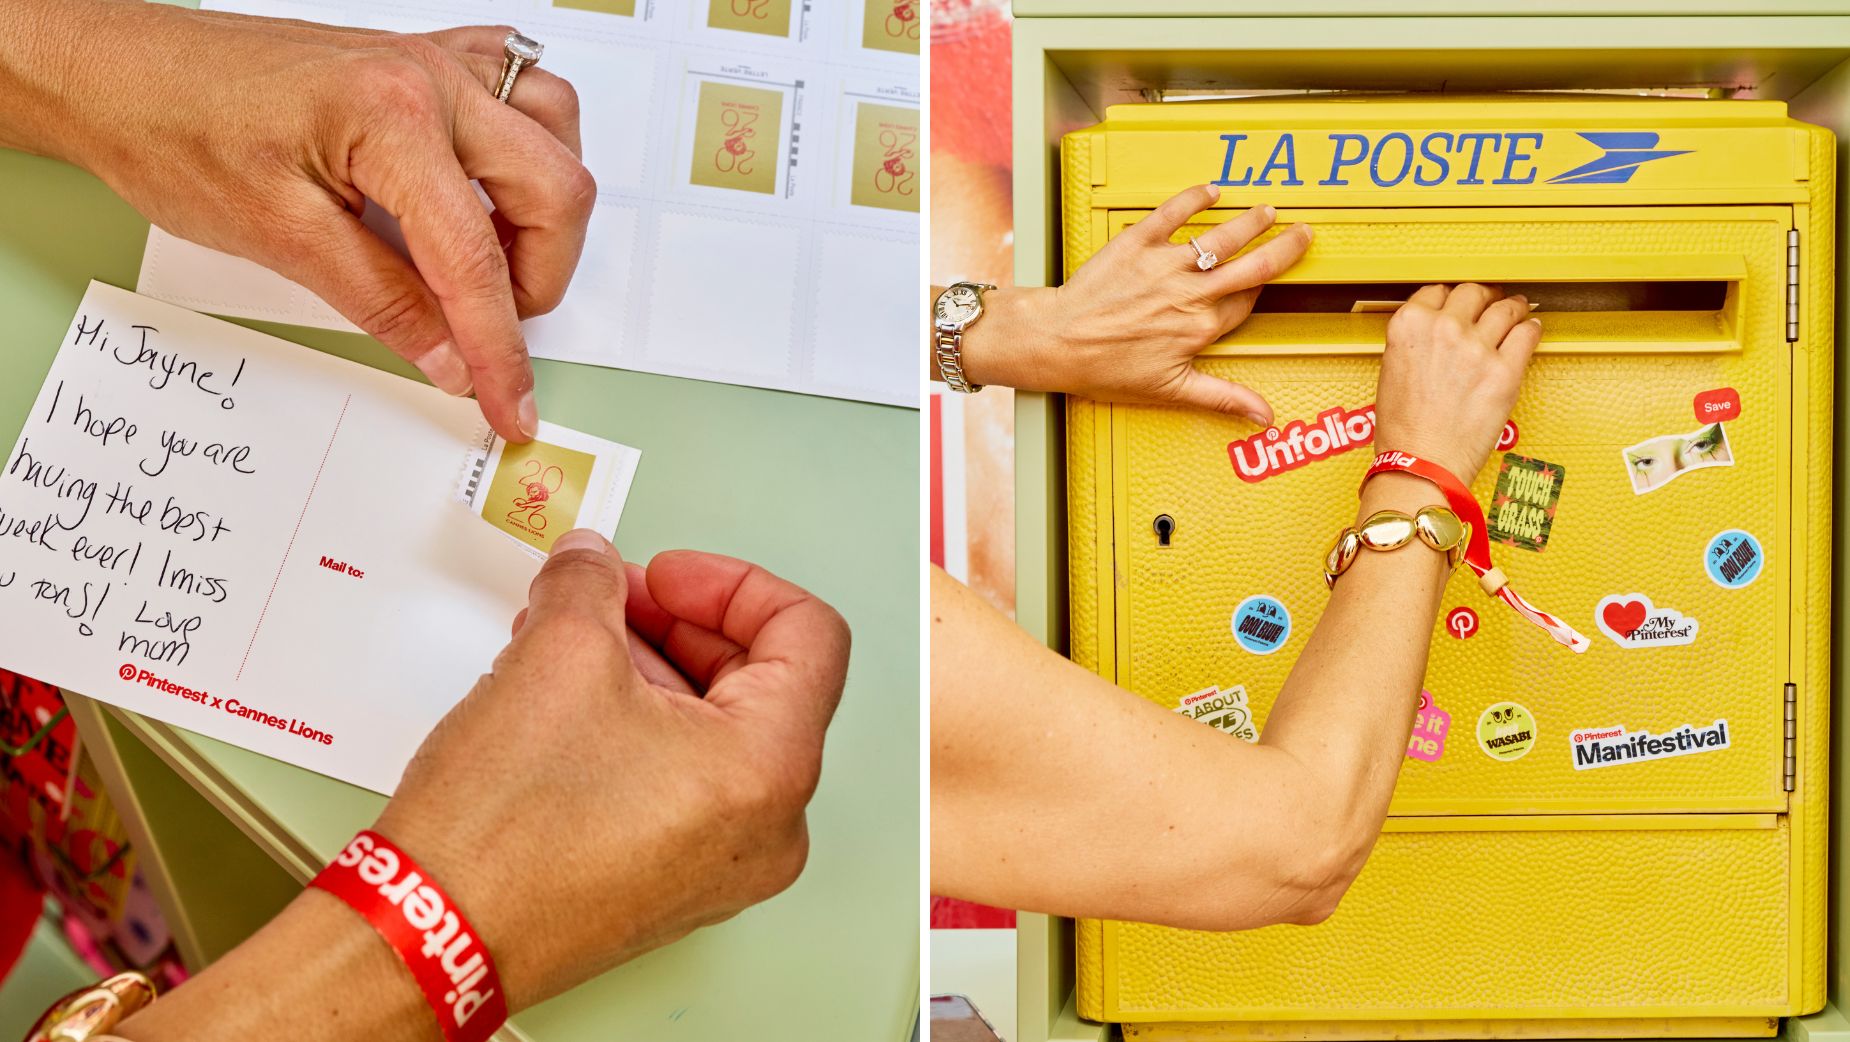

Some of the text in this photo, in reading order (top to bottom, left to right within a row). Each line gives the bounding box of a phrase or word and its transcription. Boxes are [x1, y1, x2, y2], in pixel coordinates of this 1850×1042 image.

[1210, 132, 1544, 188] LA POSTE
[75, 315, 245, 409] Hi Jayne!
[1704, 401, 1731, 413] Save
[74, 395, 137, 445] hope
[140, 431, 197, 476] you
[204, 443, 255, 473] are
[11, 437, 231, 541] having the best
[519, 460, 563, 494] 20
[1507, 466, 1554, 507] TOUCH
[1498, 501, 1544, 539] GRASS
[72, 536, 141, 585] ever!
[171, 567, 227, 602] miss
[319, 556, 365, 579] Mail to:
[135, 601, 201, 641] Love
[1643, 617, 1676, 631] My
[136, 670, 334, 745] Pinterest x Cannes Lions
[1195, 691, 1241, 718] ABOUT
[1427, 713, 1444, 735] it
[1486, 730, 1532, 749] WASABI
[1576, 723, 1727, 765] Manifestival
[1585, 729, 1622, 741] Pinterest
